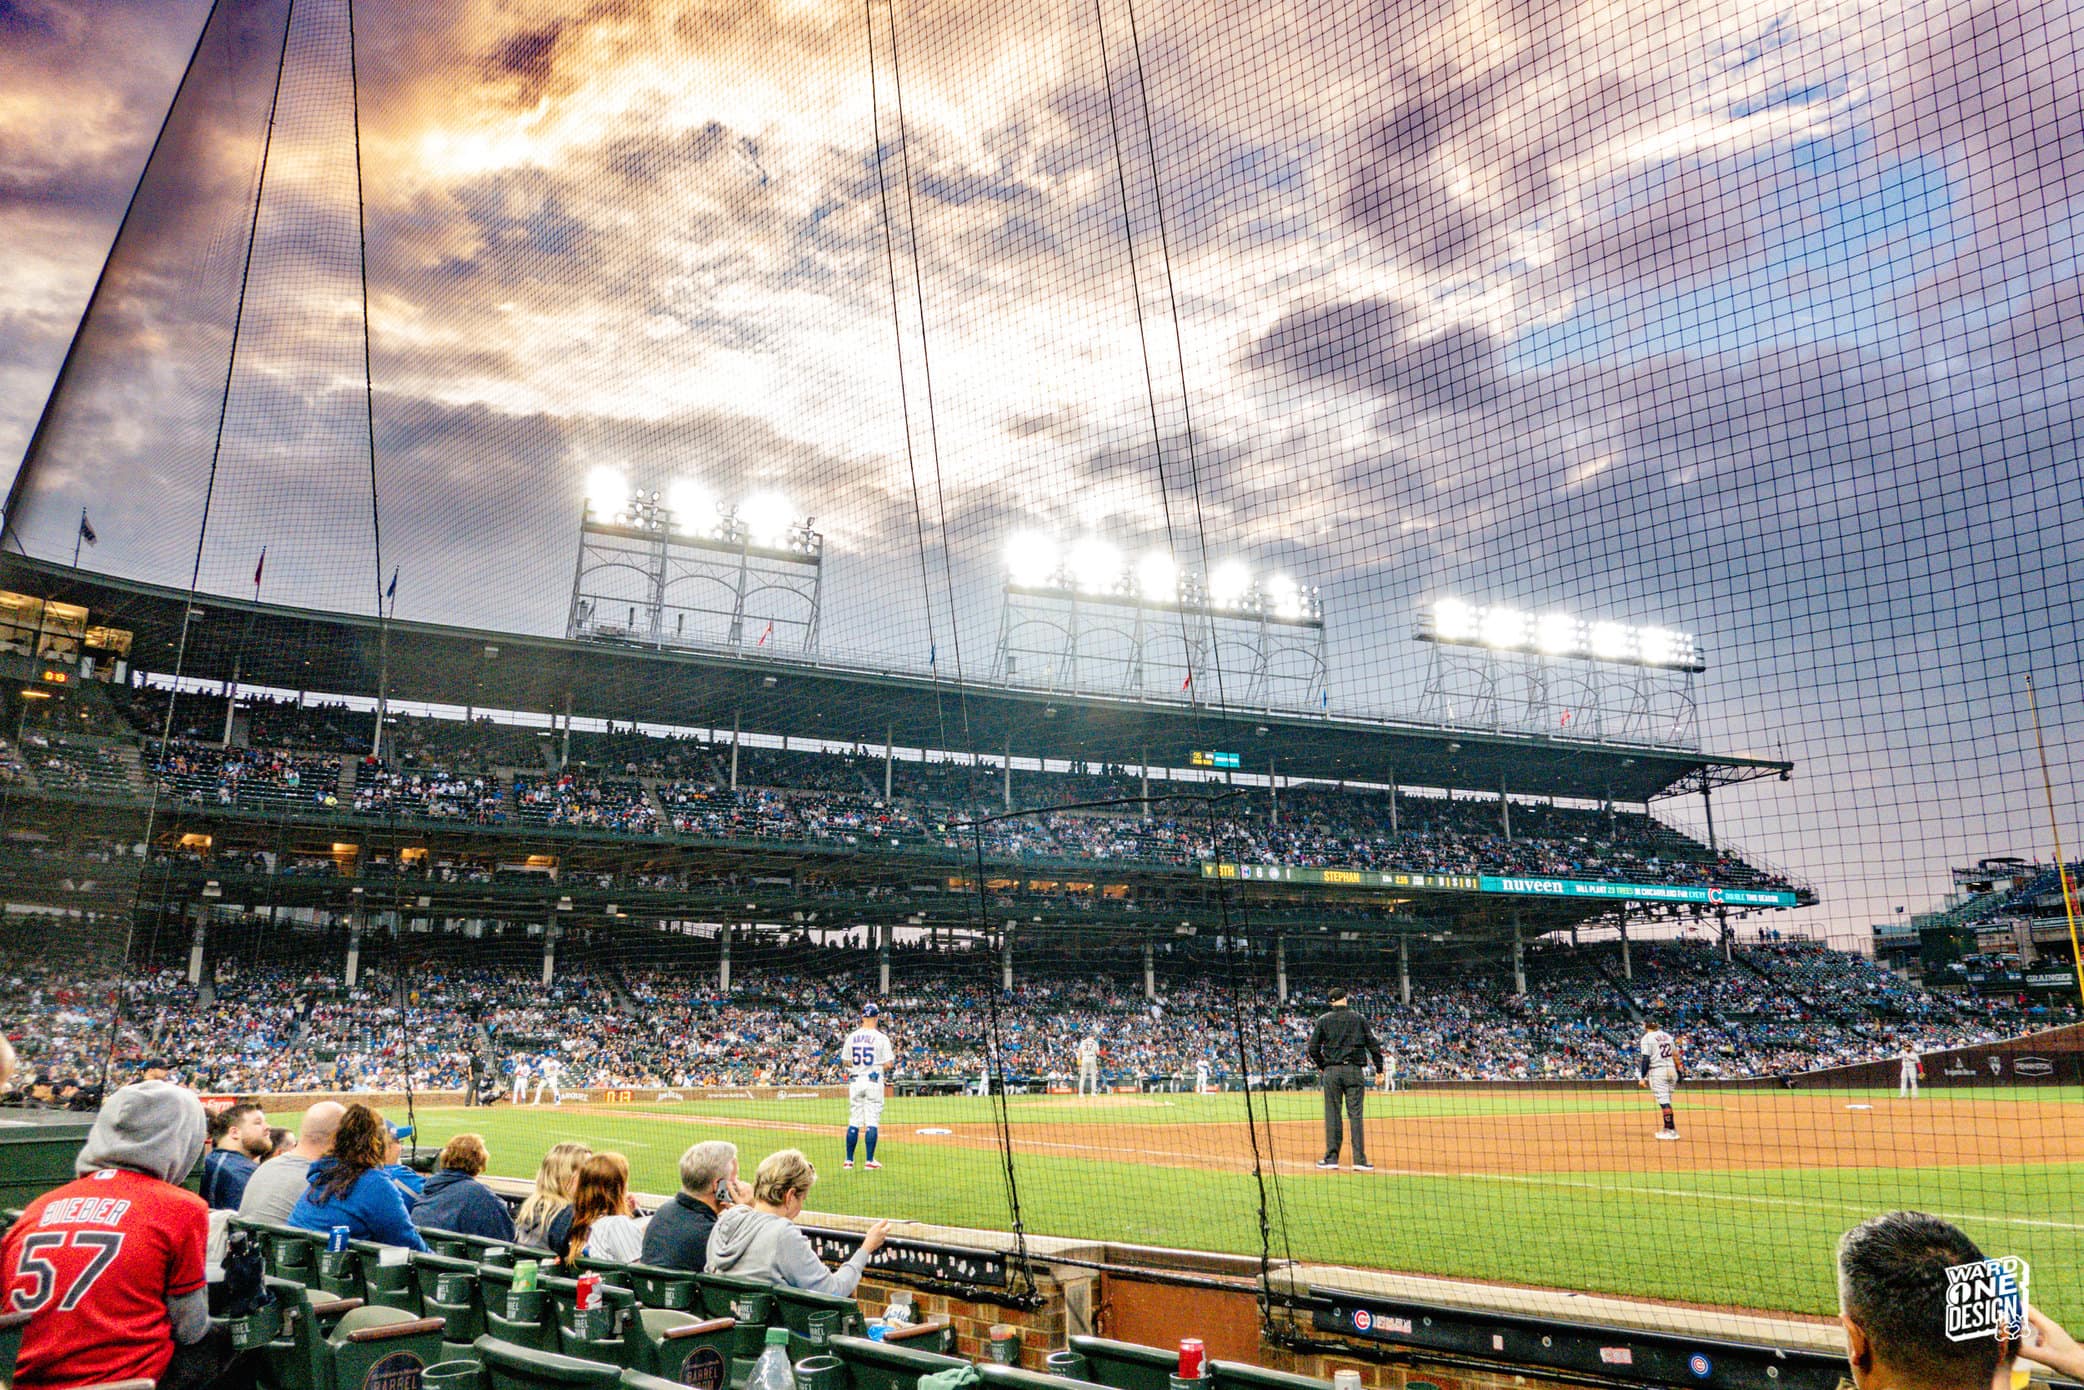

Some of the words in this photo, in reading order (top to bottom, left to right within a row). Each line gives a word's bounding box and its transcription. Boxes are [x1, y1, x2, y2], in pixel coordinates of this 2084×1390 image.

[1323, 870, 1360, 883] STEPHAN
[1501, 879, 1563, 893] nuveen
[852, 1046, 875, 1066] 55
[1659, 1043, 1672, 1058] 22
[38, 1197, 131, 1227] BIEBER
[11, 1230, 126, 1313] 57
